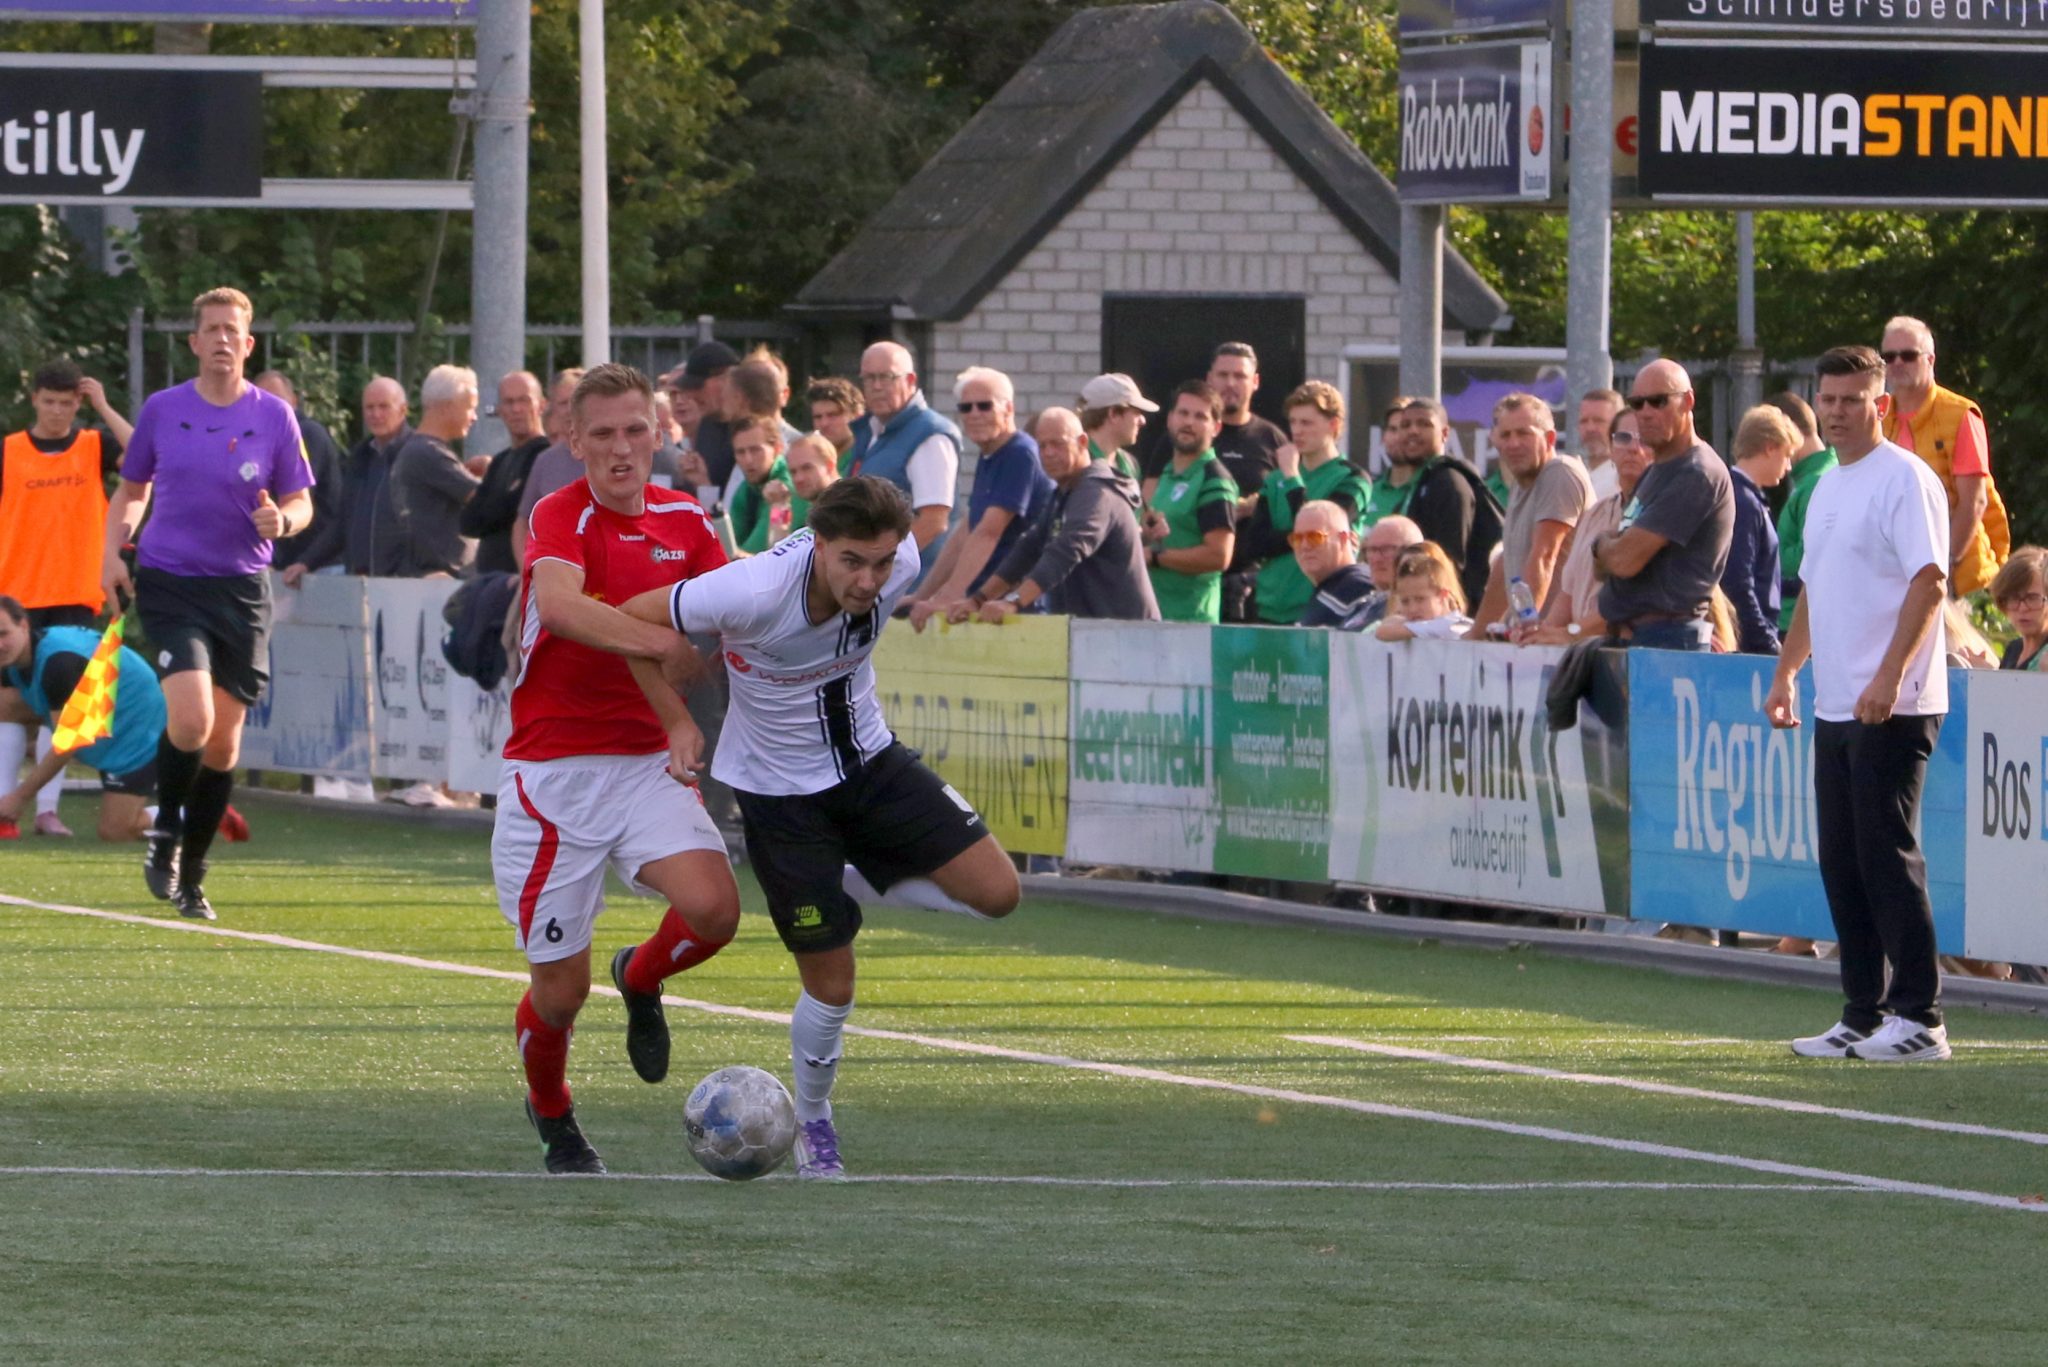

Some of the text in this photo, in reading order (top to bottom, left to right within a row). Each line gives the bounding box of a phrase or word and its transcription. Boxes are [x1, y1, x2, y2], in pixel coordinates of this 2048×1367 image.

[0, 109, 145, 195] tilly
[1401, 74, 1511, 171] Rabobank
[1386, 652, 1527, 802] korterink
[1983, 731, 2031, 841] Bos
[1449, 814, 1528, 890] autobedrijf
[545, 916, 564, 943] 6
